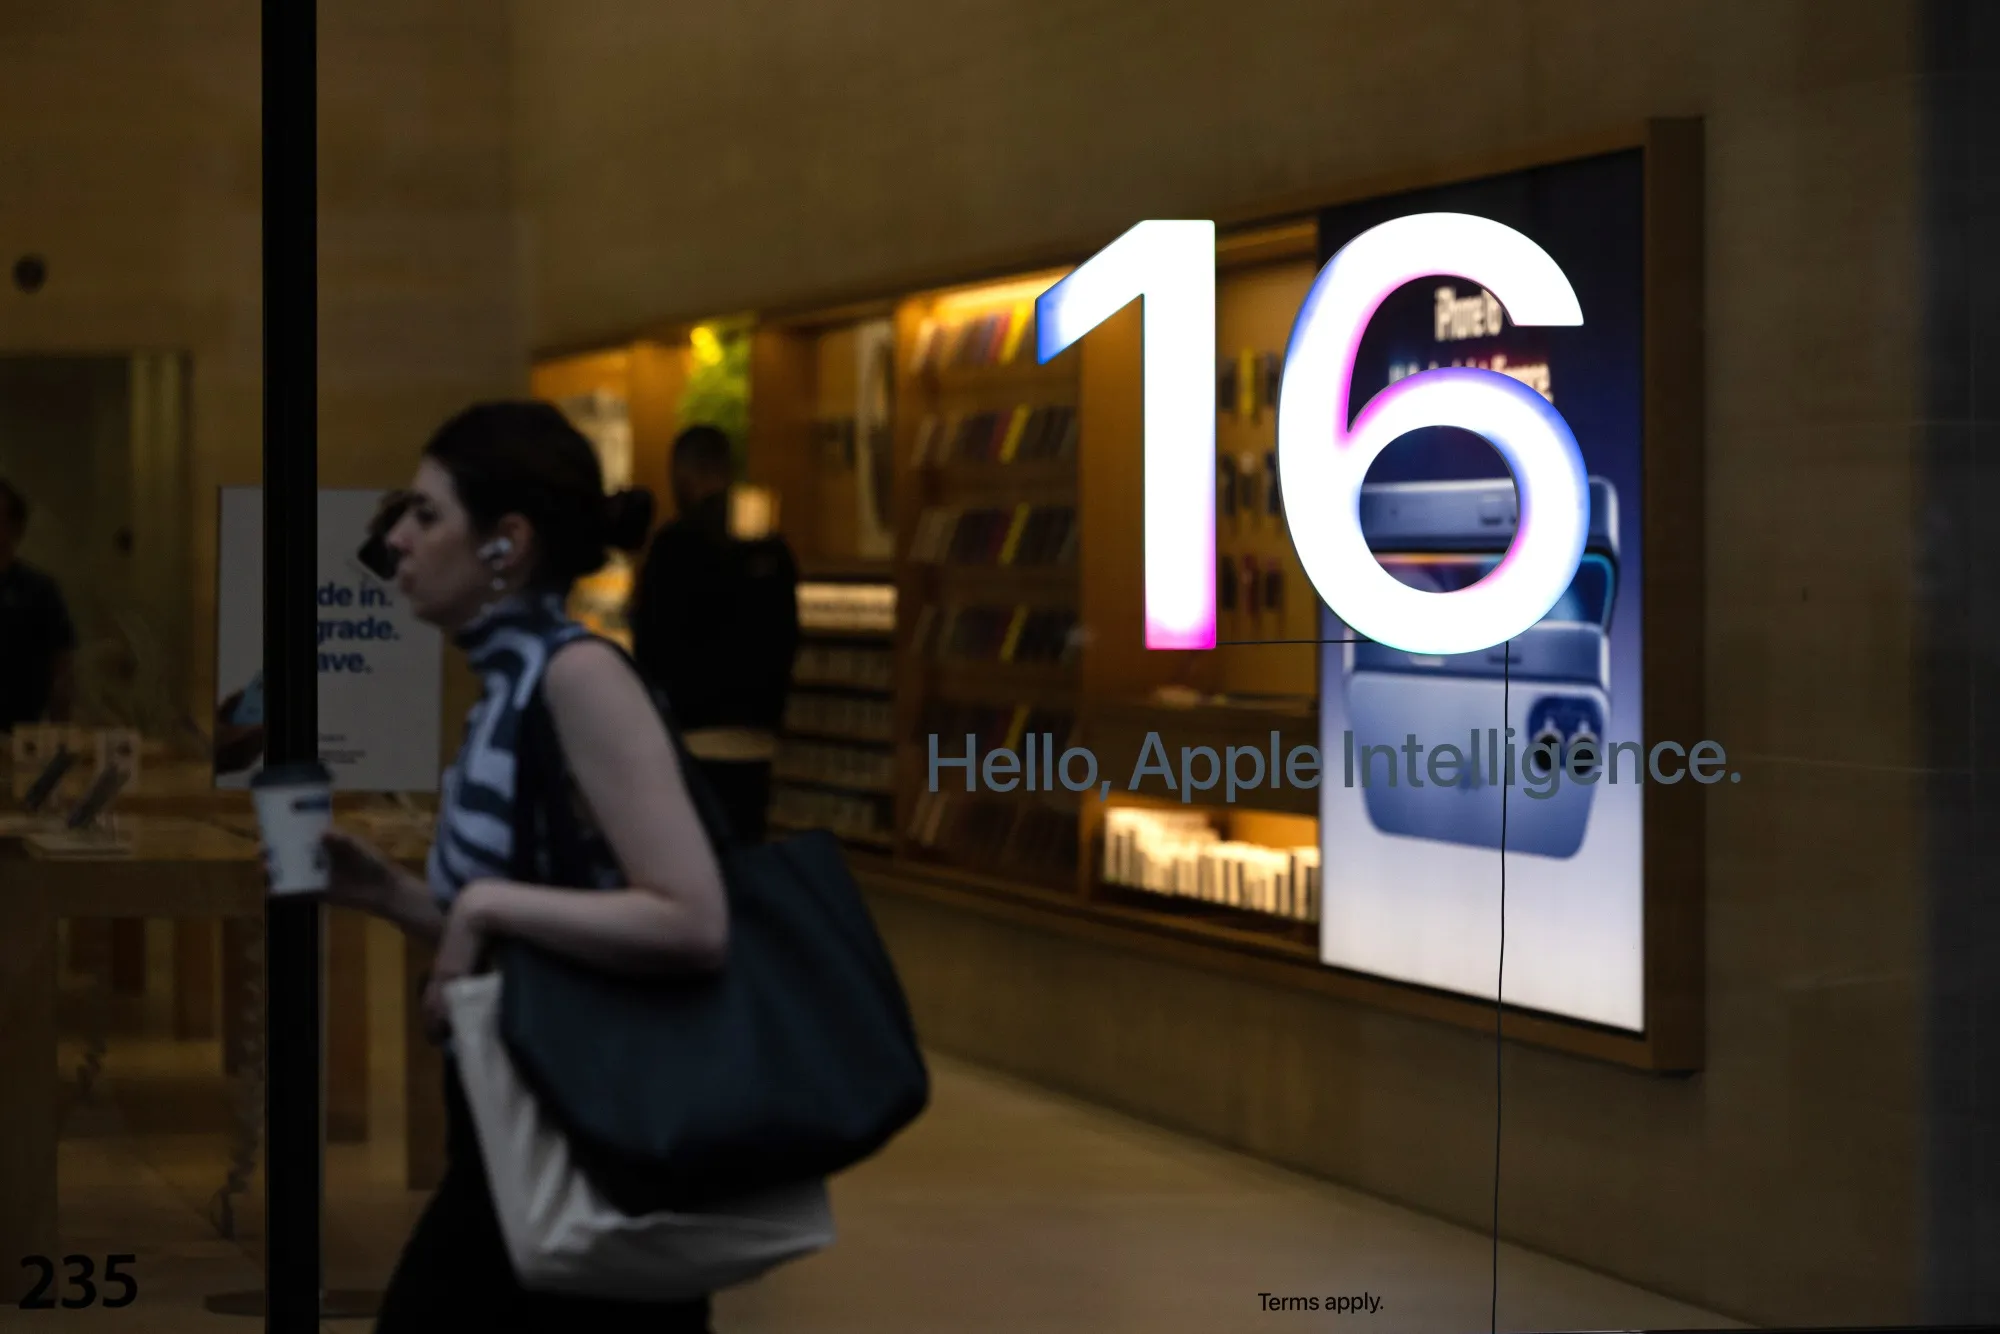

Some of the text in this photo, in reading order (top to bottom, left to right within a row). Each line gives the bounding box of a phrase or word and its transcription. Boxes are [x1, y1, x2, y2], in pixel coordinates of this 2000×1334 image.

[1035, 211, 1590, 654] 16
[316, 653, 373, 674] ave.
[927, 727, 1742, 804] Hello, Apple Intelligence.
[18, 1254, 138, 1309] 235
[1257, 1291, 1384, 1315] Terms apply.
